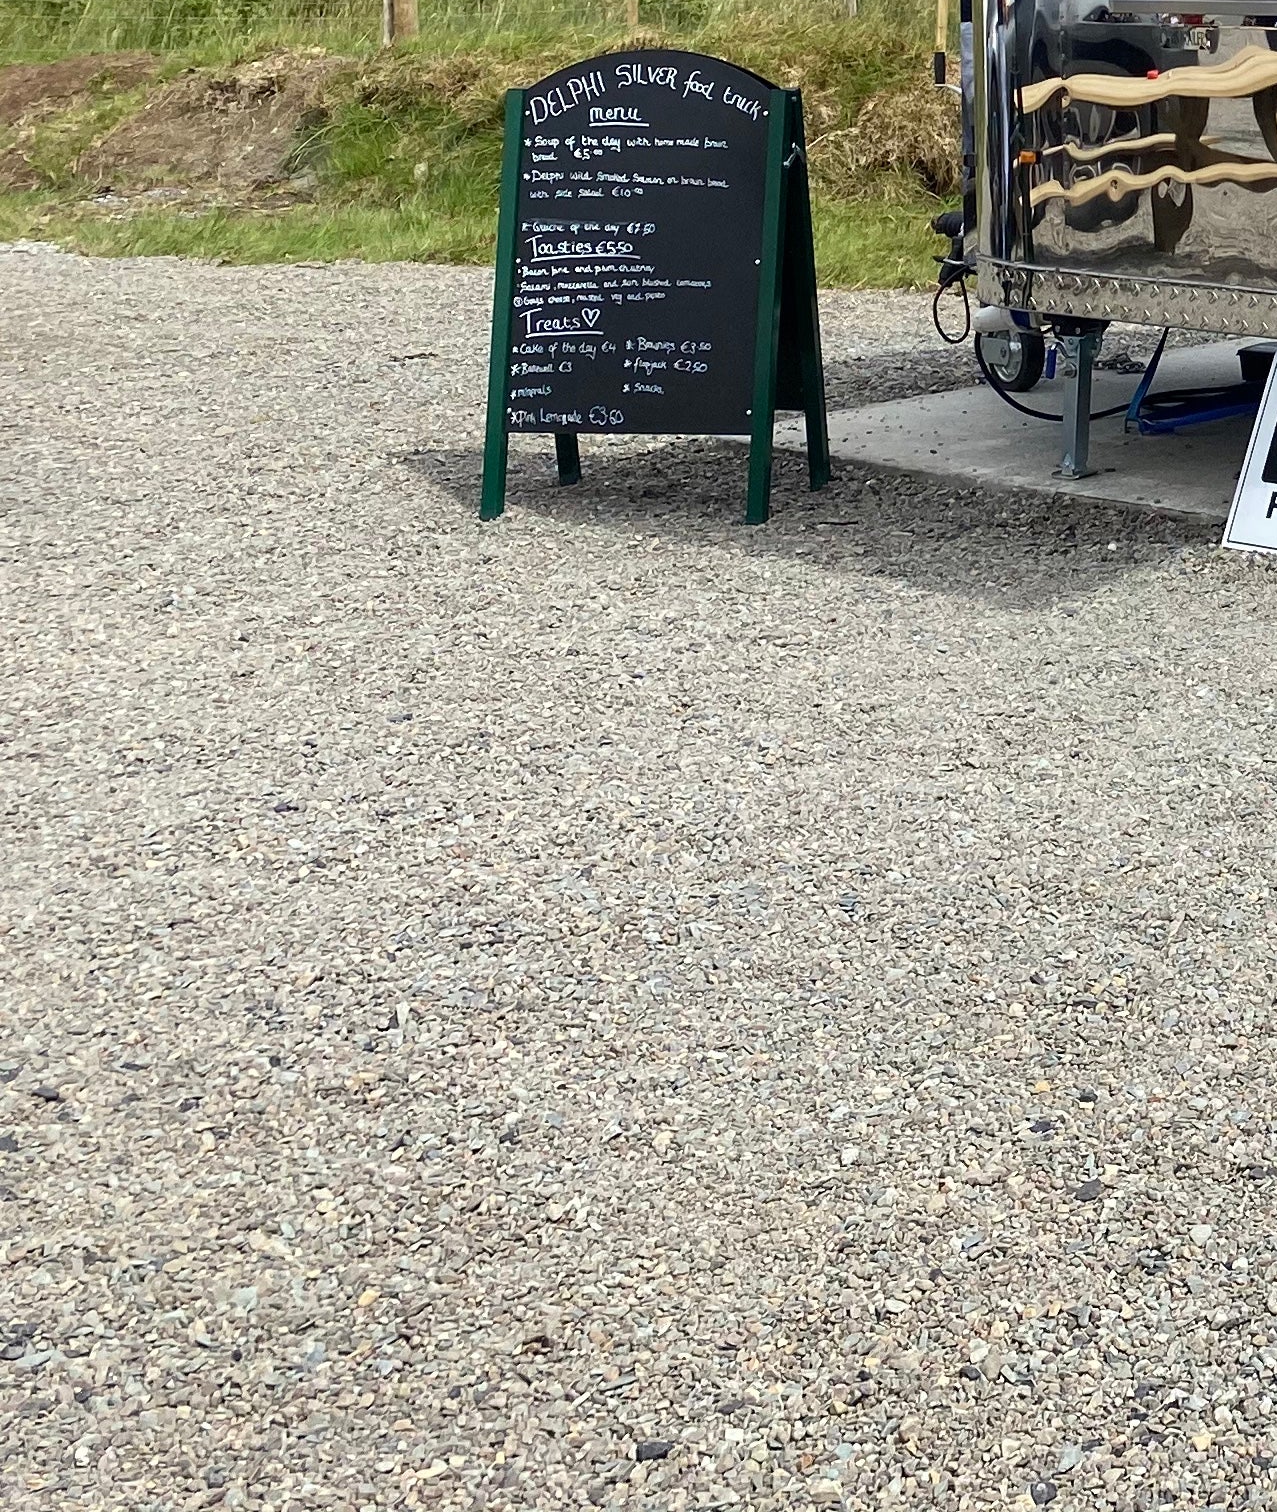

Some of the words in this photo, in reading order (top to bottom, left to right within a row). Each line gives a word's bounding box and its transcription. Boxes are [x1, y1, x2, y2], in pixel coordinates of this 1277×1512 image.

[529, 71, 606, 125] DELPHI
[615, 64, 677, 89] SILVER
[683, 70, 713, 100] food
[723, 87, 761, 121] truck
[535, 136, 560, 150] Soup
[565, 136, 575, 151] of
[582, 135, 598, 146] the
[602, 136, 621, 153] day
[627, 138, 651, 147] with
[525, 235, 592, 257] Toasties
[519, 307, 581, 334] Treats
[548, 343, 558, 359] of
[562, 343, 577, 354] the
[579, 343, 597, 360] day
